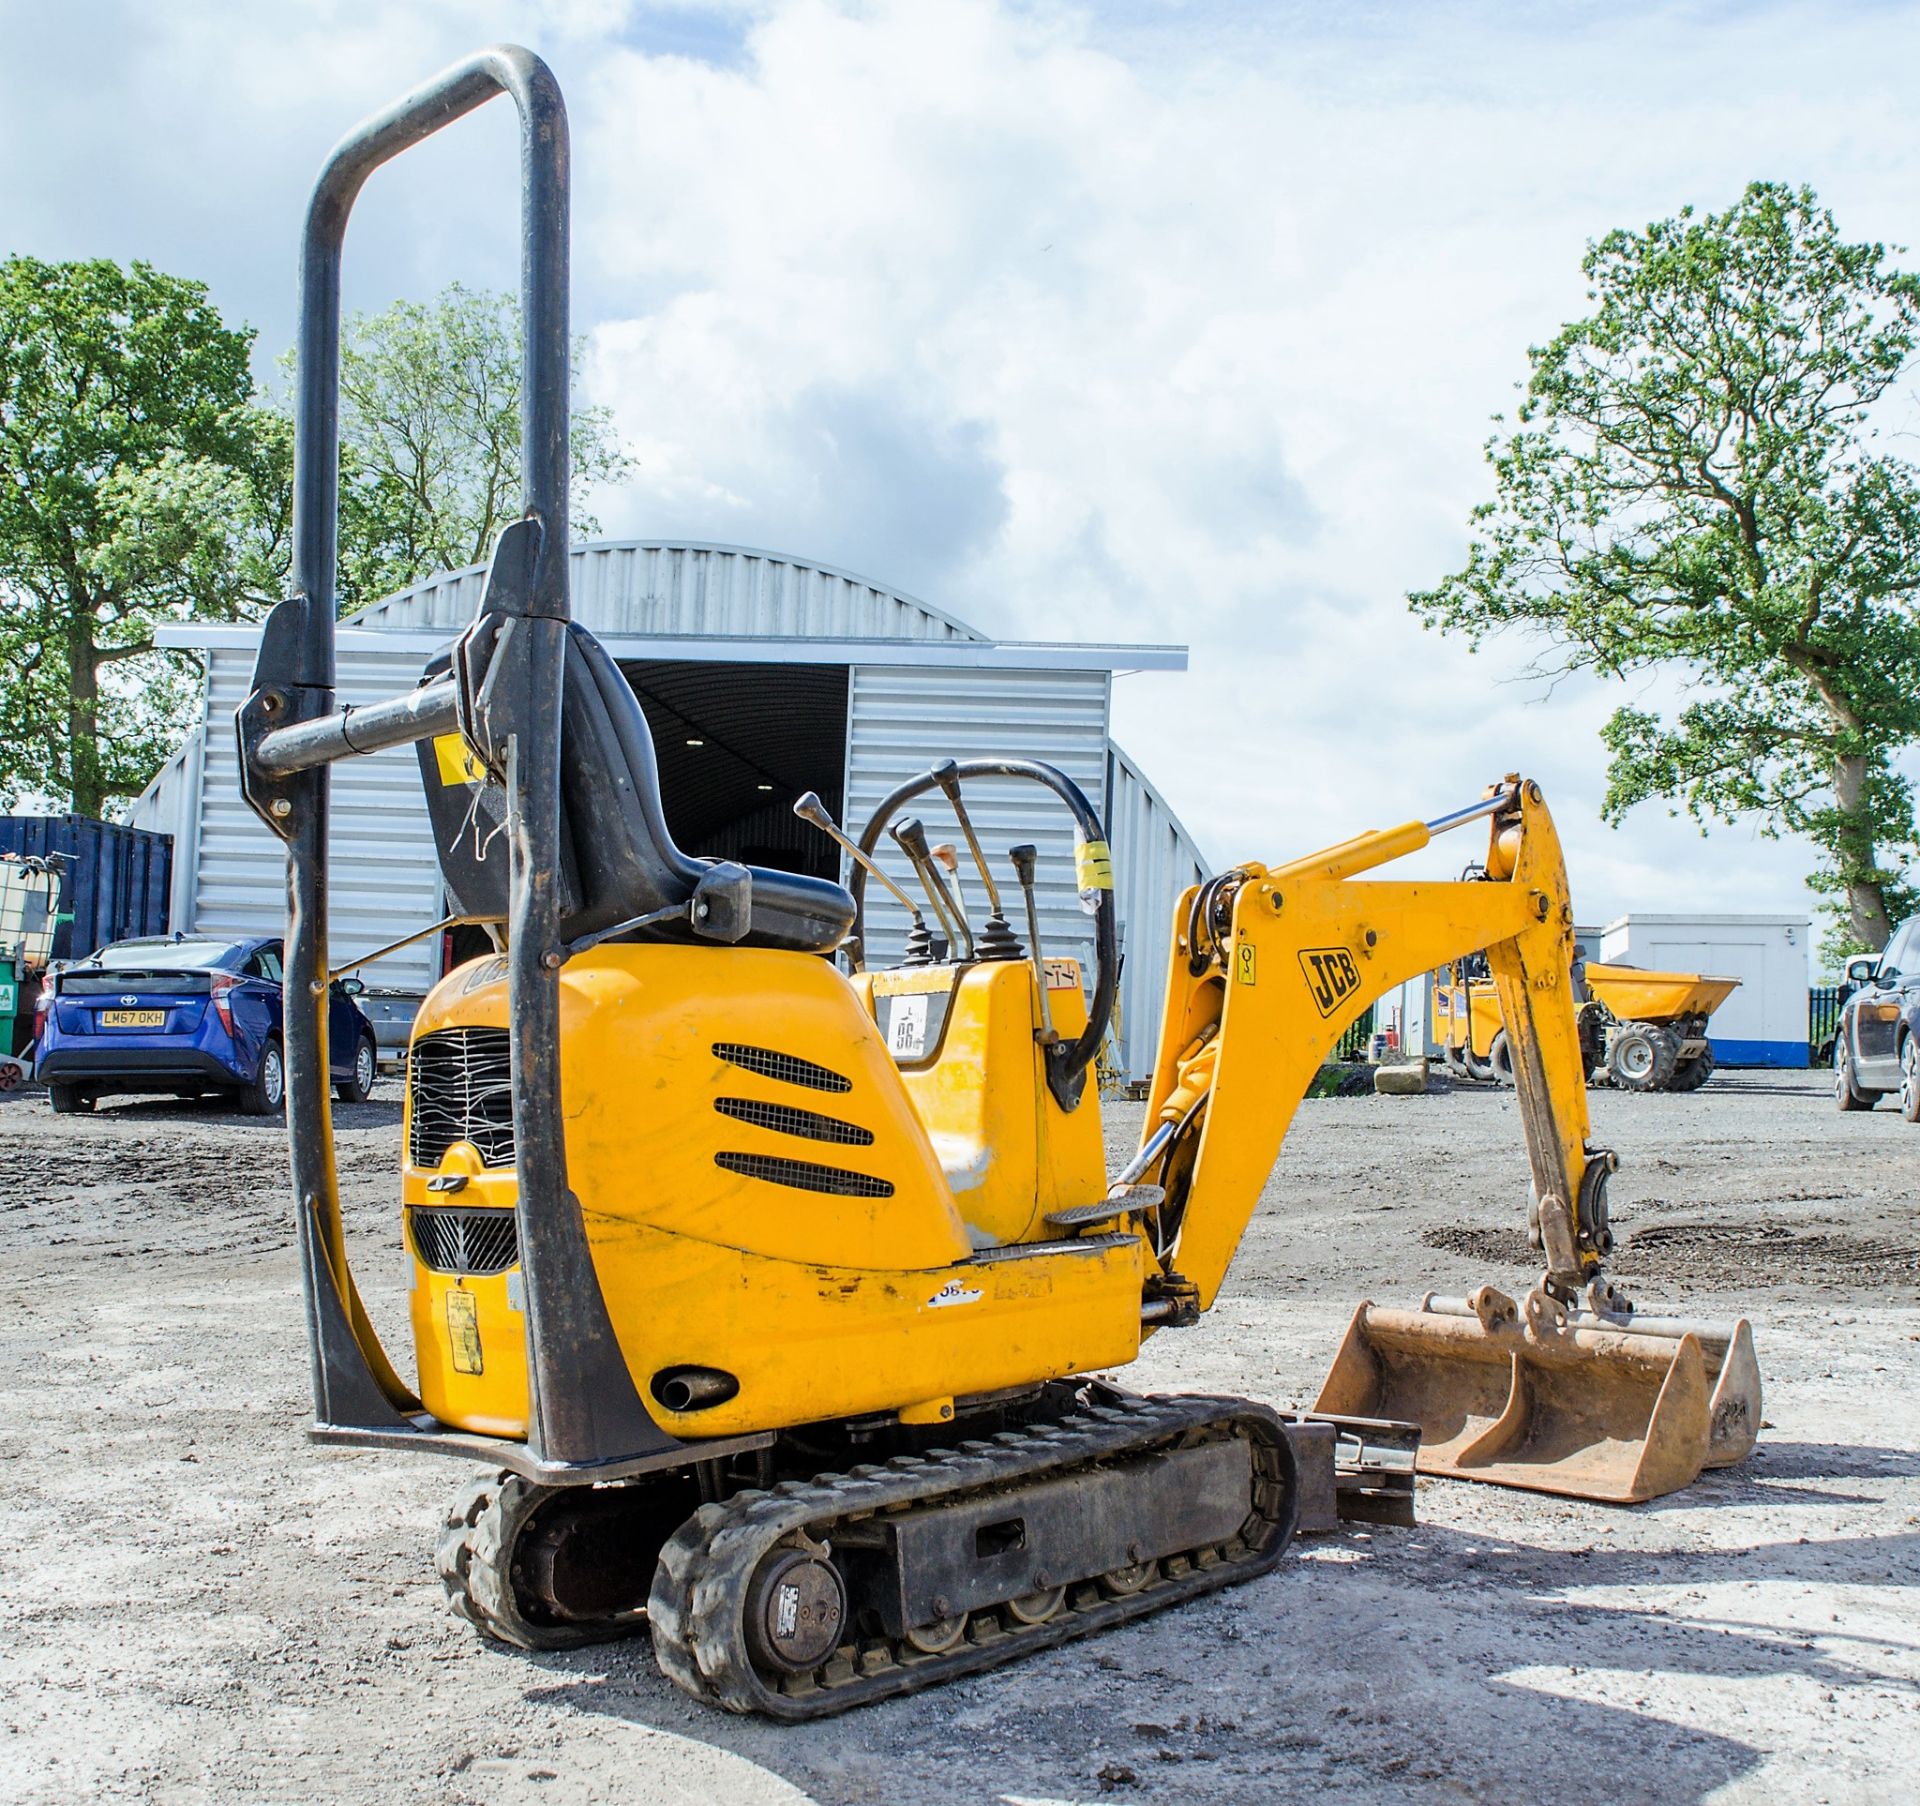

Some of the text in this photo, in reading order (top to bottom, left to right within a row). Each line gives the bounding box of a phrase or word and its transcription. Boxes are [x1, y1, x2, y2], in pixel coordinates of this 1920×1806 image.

[1309, 952, 1357, 1009] JCB
[104, 1011, 163, 1024] LM67 OKH
